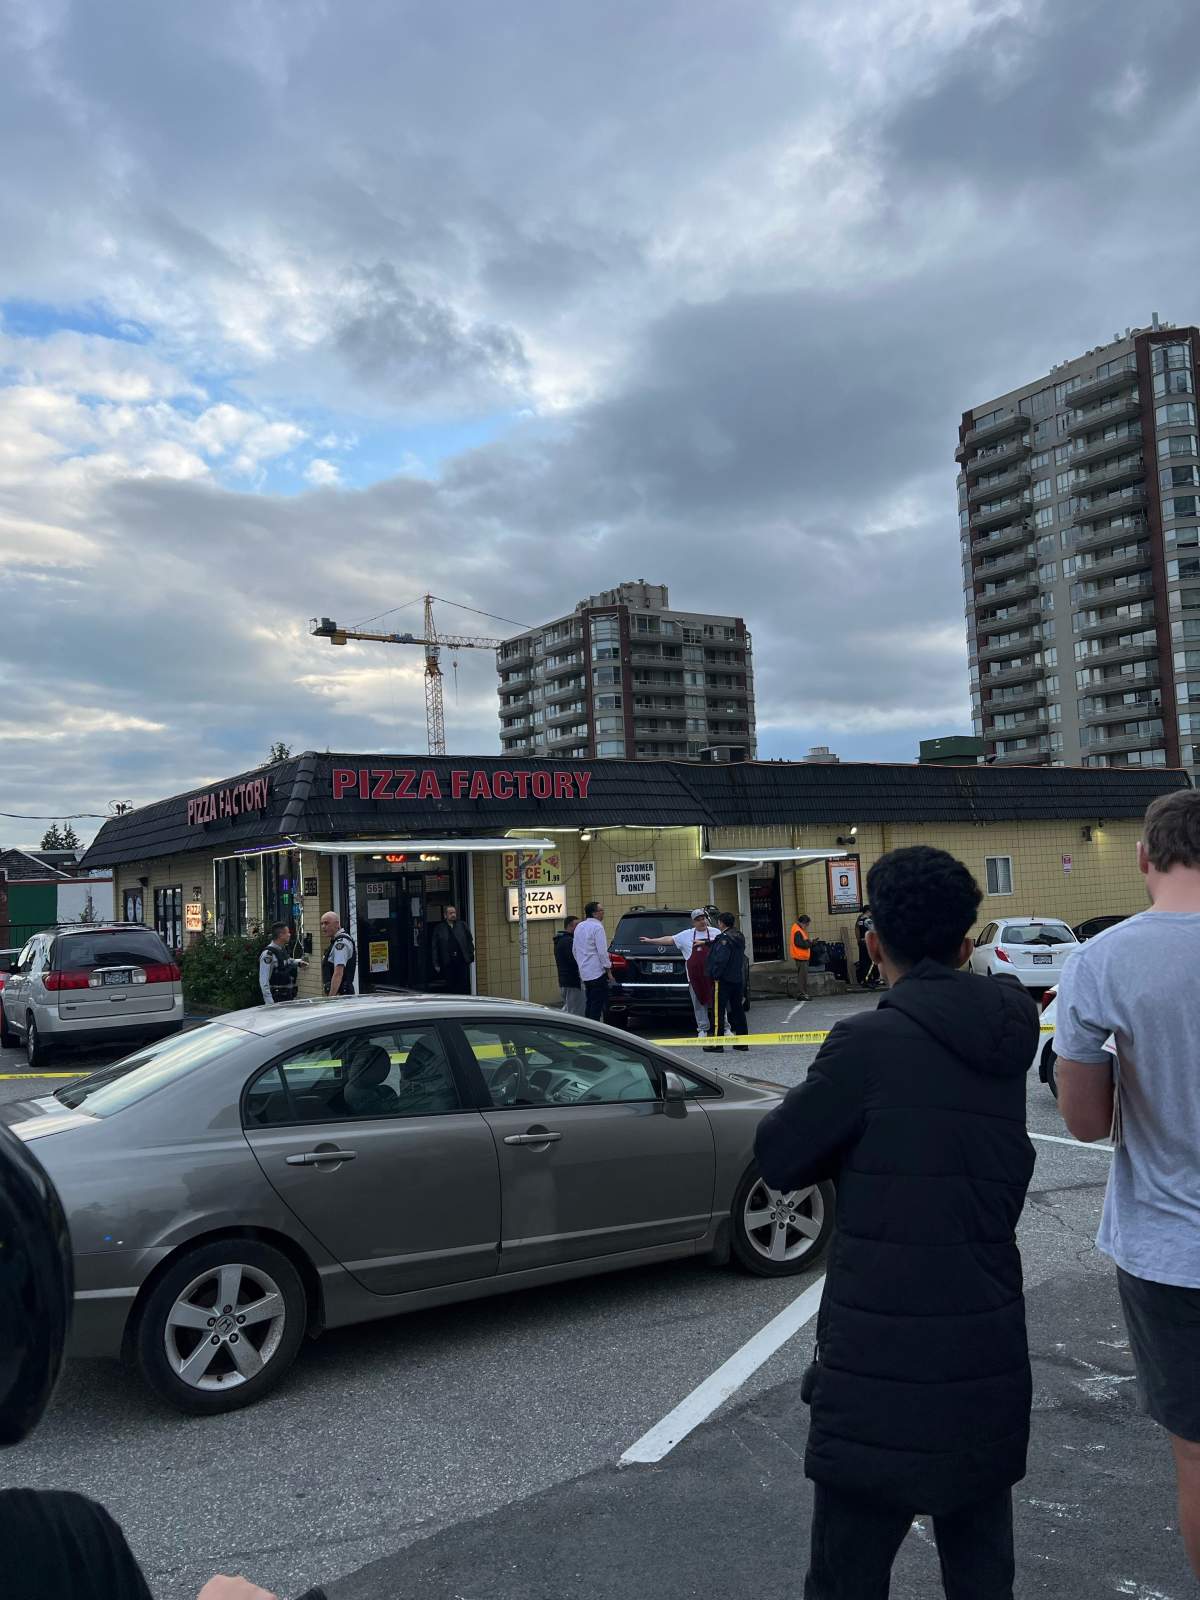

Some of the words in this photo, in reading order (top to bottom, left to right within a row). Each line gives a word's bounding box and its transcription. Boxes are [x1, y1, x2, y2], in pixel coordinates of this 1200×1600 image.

[332, 769, 442, 800] PIZZA
[450, 770, 592, 799] FACTORY
[187, 793, 217, 825] PIZZA
[219, 776, 269, 818] FACTORY
[616, 863, 654, 872] CUSTOMER
[620, 873, 651, 882] PARKING
[367, 883, 383, 893] 565
[628, 883, 645, 892] ONLY
[526, 891, 553, 902] IZZA
[512, 904, 562, 916] FCTORY
